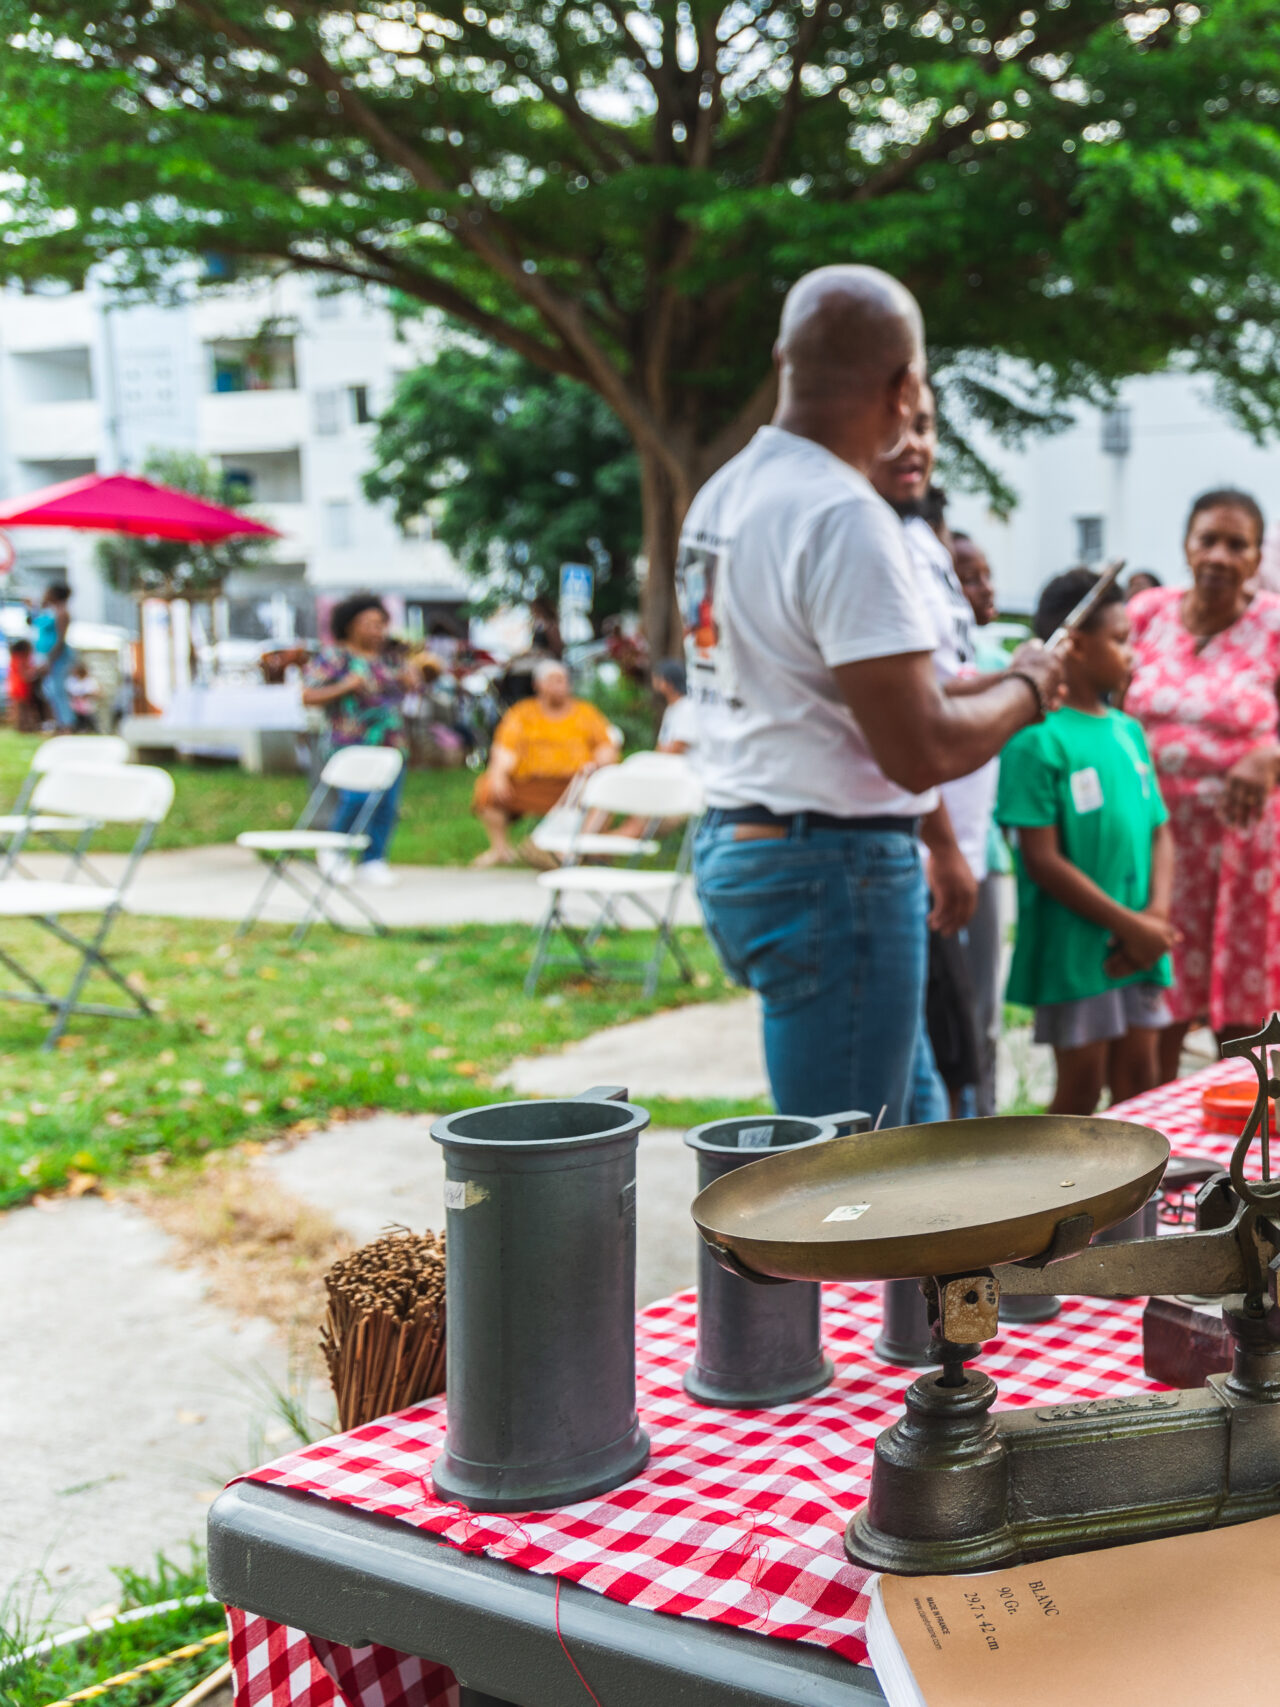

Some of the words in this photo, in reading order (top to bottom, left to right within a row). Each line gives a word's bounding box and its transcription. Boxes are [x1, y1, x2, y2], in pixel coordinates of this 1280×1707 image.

[996, 1586, 1015, 1599] 90
[1028, 1580, 1060, 1617] BLANC
[963, 1592, 986, 1612] 29,7
[1004, 1600, 1020, 1616] Gr.
[926, 1597, 938, 1611] MADE
[935, 1615, 951, 1635] FRANCE
[974, 1612, 985, 1620] x
[978, 1620, 996, 1634] 42
[985, 1635, 1000, 1651] cm
